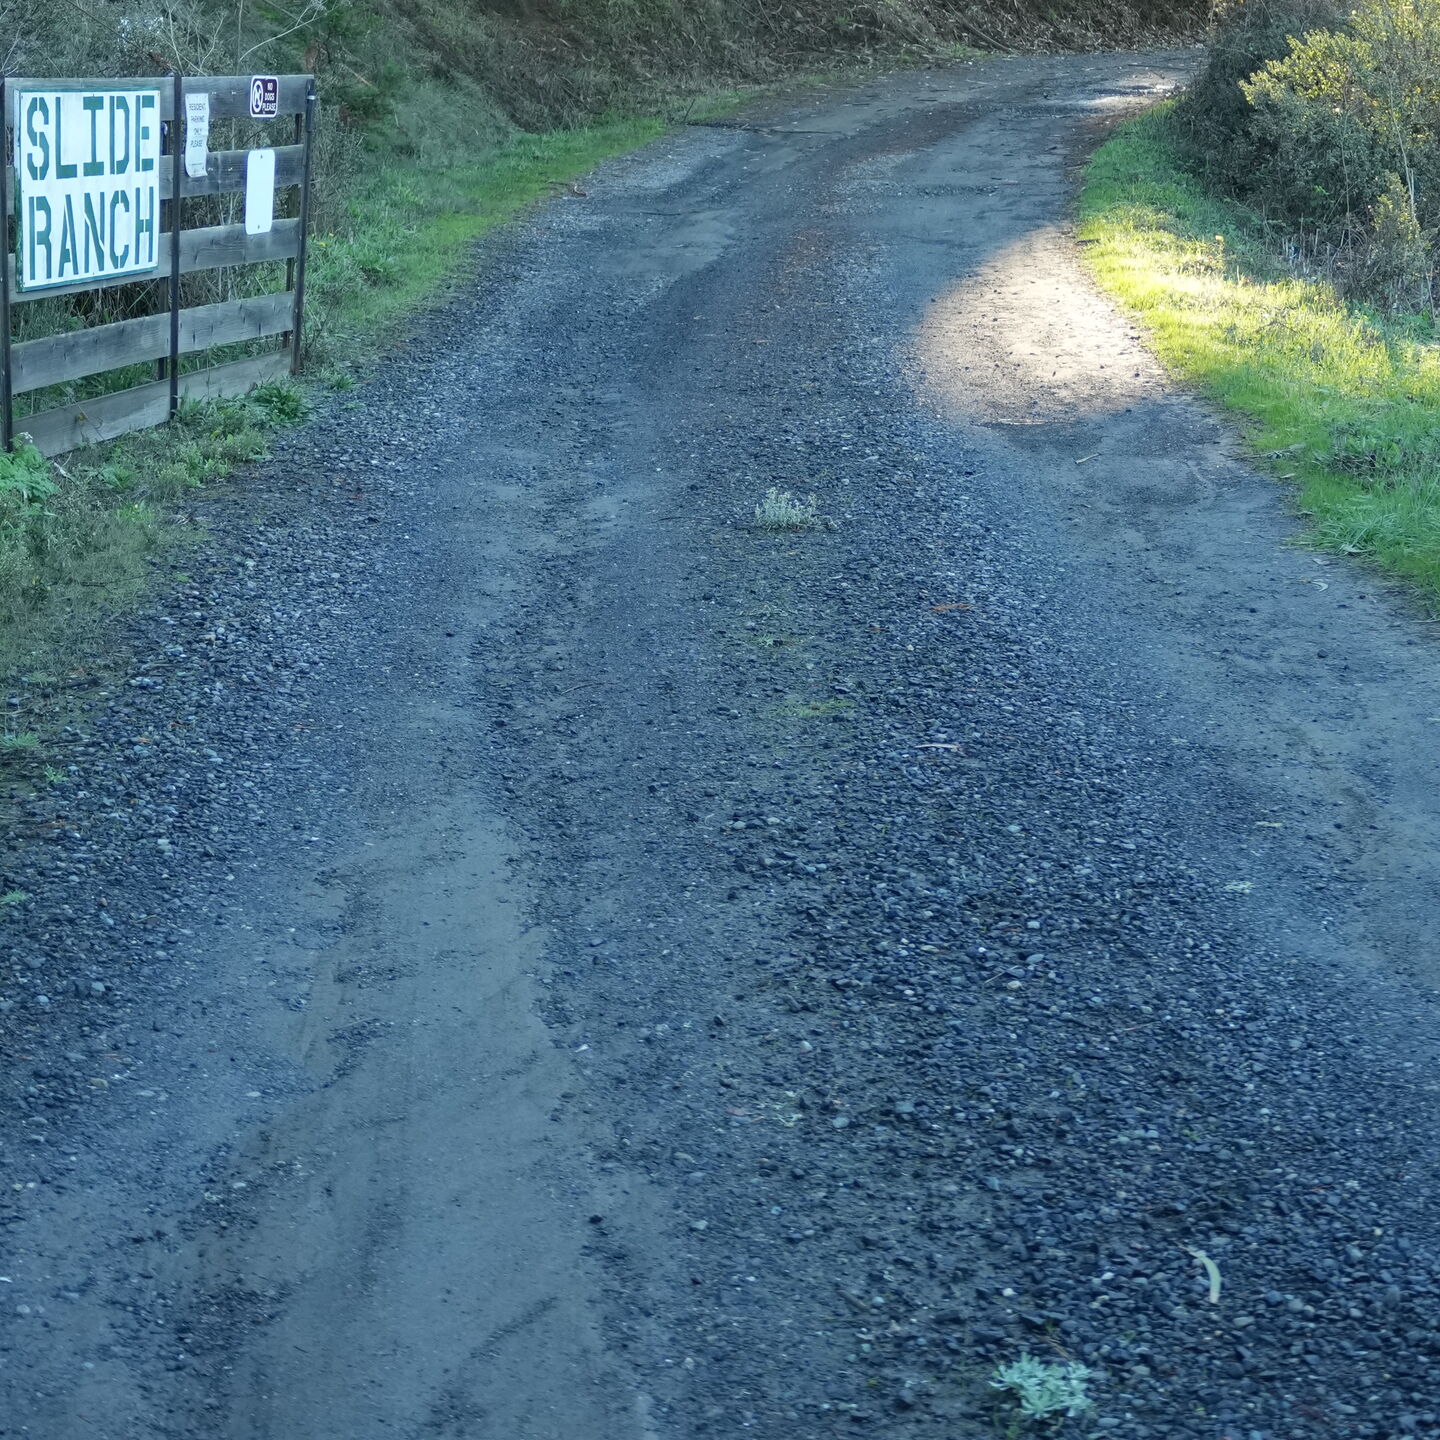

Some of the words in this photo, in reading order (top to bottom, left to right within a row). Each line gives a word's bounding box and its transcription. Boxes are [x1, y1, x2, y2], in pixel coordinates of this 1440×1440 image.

[267, 82, 274, 91] NO
[264, 93, 275, 101] DOGS
[262, 102, 277, 111] PLEASE
[27, 95, 155, 180] SLIDE
[28, 186, 154, 280] RANCH
